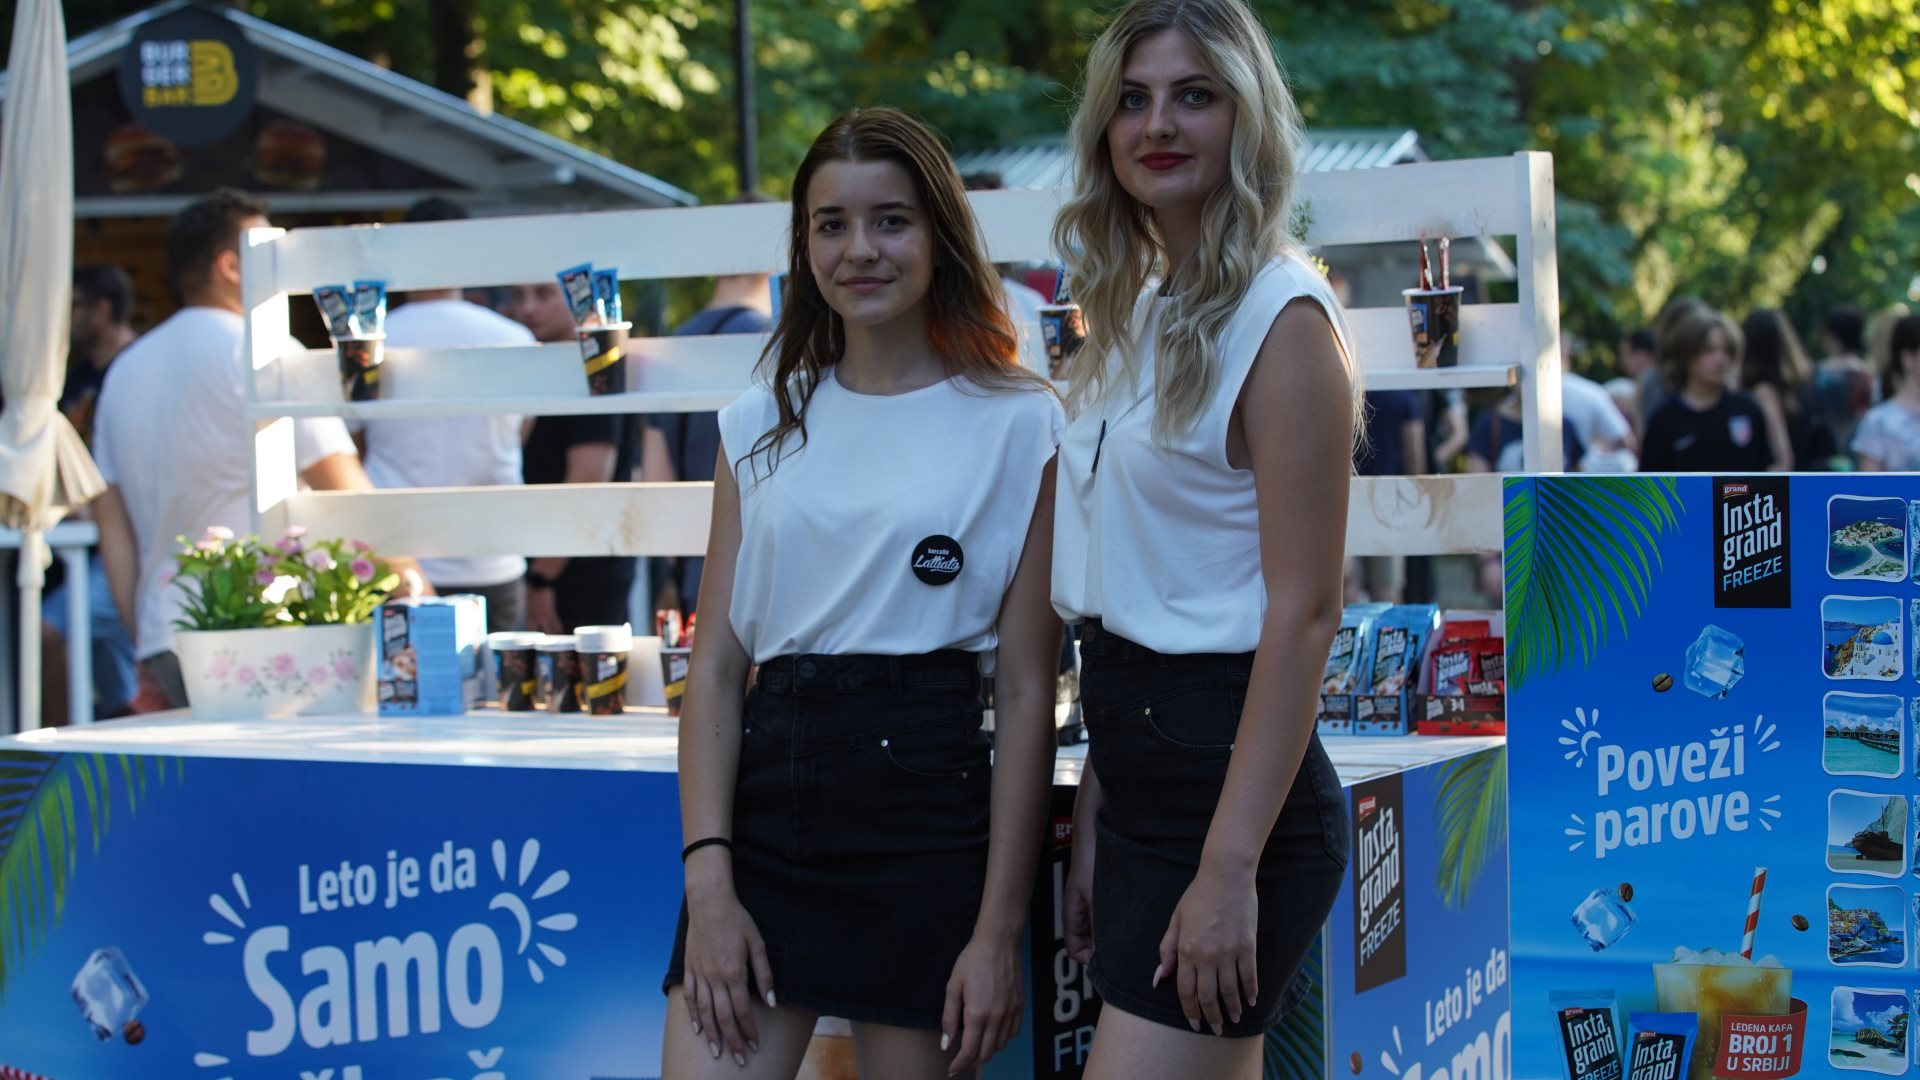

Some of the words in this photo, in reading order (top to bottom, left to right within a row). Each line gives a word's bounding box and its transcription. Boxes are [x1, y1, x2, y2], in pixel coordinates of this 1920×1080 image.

[141, 41, 189, 62] BUR
[1724, 484, 1748, 494] grand
[1723, 493, 1775, 536] Insta
[1723, 511, 1782, 570] grand
[1723, 556, 1782, 591] FREEZE
[1597, 724, 1745, 796] Poveži
[1359, 807, 1395, 880] Insta
[1595, 790, 1750, 859] parove
[299, 859, 377, 914] Leto
[385, 850, 420, 909] je
[430, 840, 476, 893] da
[1360, 831, 1400, 934] grand
[1360, 898, 1401, 967] FREEZE
[243, 923, 504, 1056] Samo
[1425, 986, 1463, 1046] Leto
[1465, 966, 1482, 1020] je
[1485, 946, 1506, 995] da
[1567, 1013, 1607, 1047] Insta
[1573, 1026, 1615, 1075] grand
[1728, 1034, 1778, 1054] BROJ
[1783, 1034, 1792, 1053] 1
[1731, 1022, 1766, 1033] LEDENA
[1768, 1023, 1793, 1033] KAFA
[1634, 1038, 1674, 1069] Insta
[1726, 1057, 1739, 1071] U
[1742, 1056, 1790, 1072] SRBIJI
